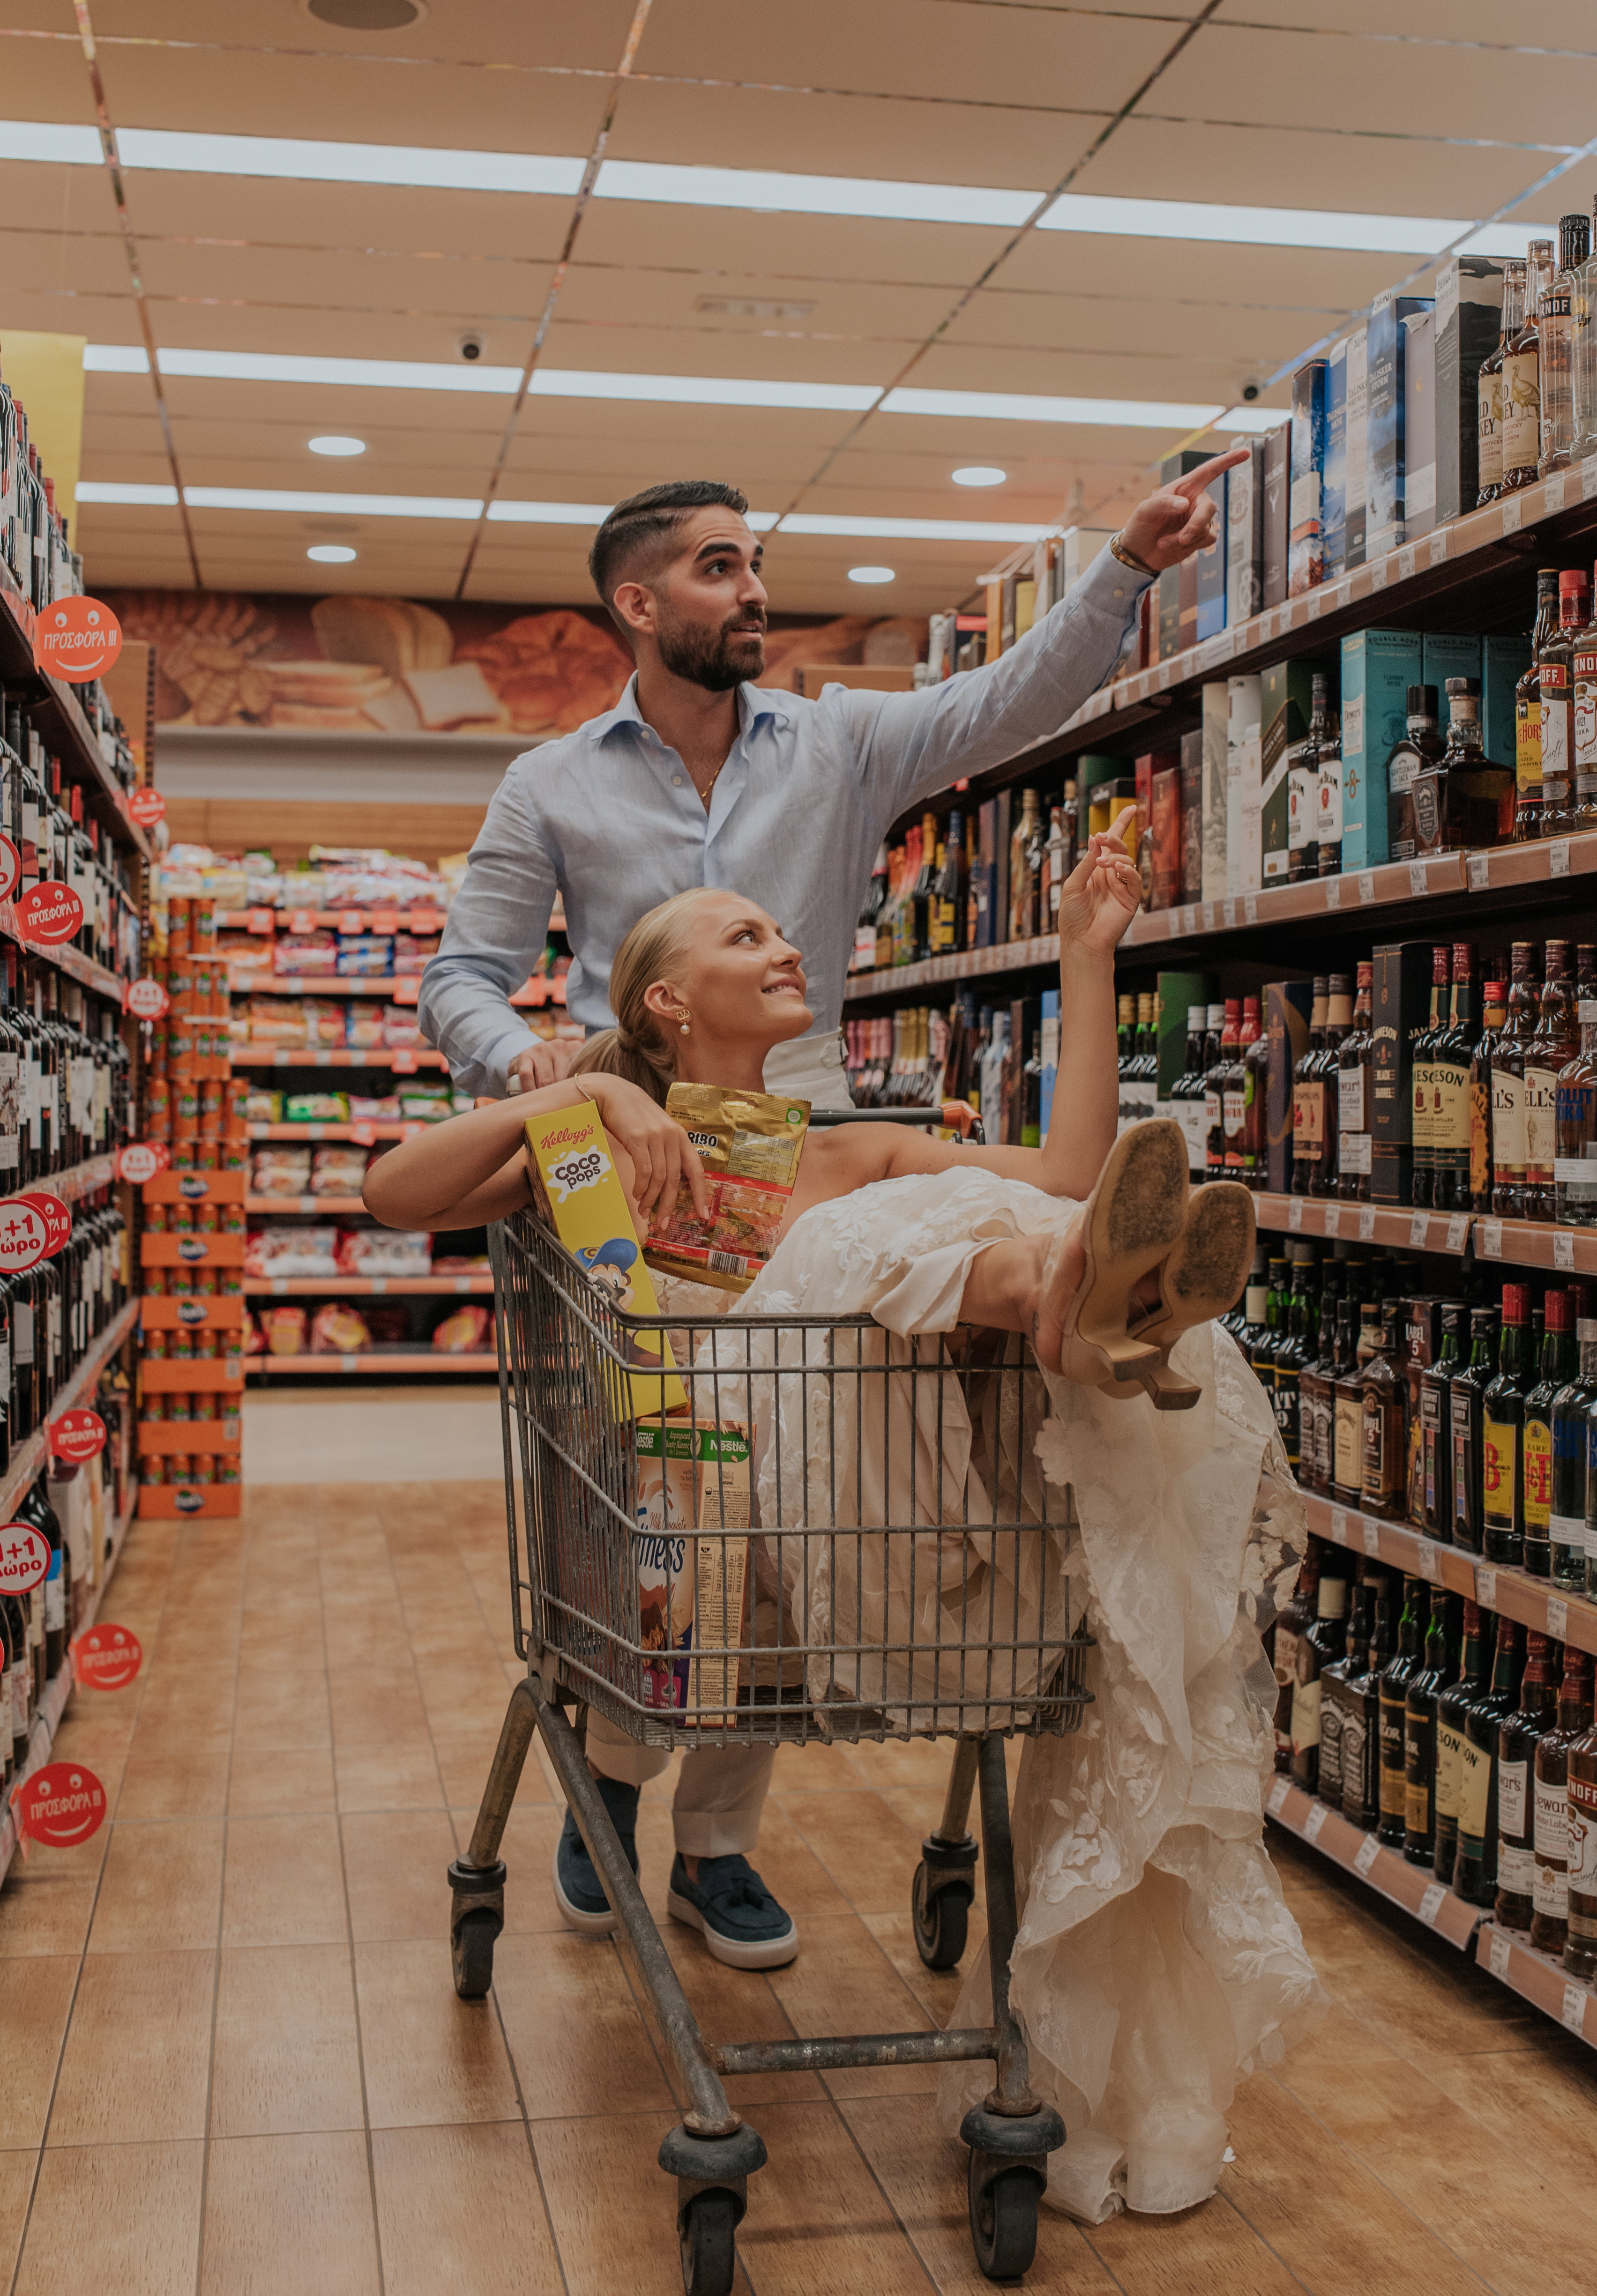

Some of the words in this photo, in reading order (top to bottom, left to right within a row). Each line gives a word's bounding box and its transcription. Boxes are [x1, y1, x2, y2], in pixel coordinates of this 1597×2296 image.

[1539, 299, 1568, 317] RNOF
[1369, 362, 1393, 384] TALISKER
[1371, 374, 1389, 392] STORM
[44, 631, 106, 650] ΠΡΟΣΦΟΡΑ
[28, 902, 73, 927] ΠΡΟΣΦΟΡΑ
[1373, 1026, 1398, 1043] JAMESON
[1435, 1070, 1465, 1087] ESON
[1525, 1087, 1556, 1108] ELL'S
[540, 1124, 594, 1150] Kellogg's
[687, 1131, 718, 1147] RIBO
[567, 1166, 601, 1190] pops
[0, 1237, 41, 1256] ώρο
[652, 1241, 686, 1253] www.haribo.com
[1405, 1323, 1425, 1344] LABEL
[1411, 1340, 1420, 1356] 5
[1367, 1429, 1375, 1443] 5
[1527, 1444, 1548, 1453] RARE
[650, 1512, 662, 1530] Milk
[662, 1516, 687, 1531] Cocolate
[30, 1791, 92, 1820] ΠΡΟΣΦΟΡΑ
